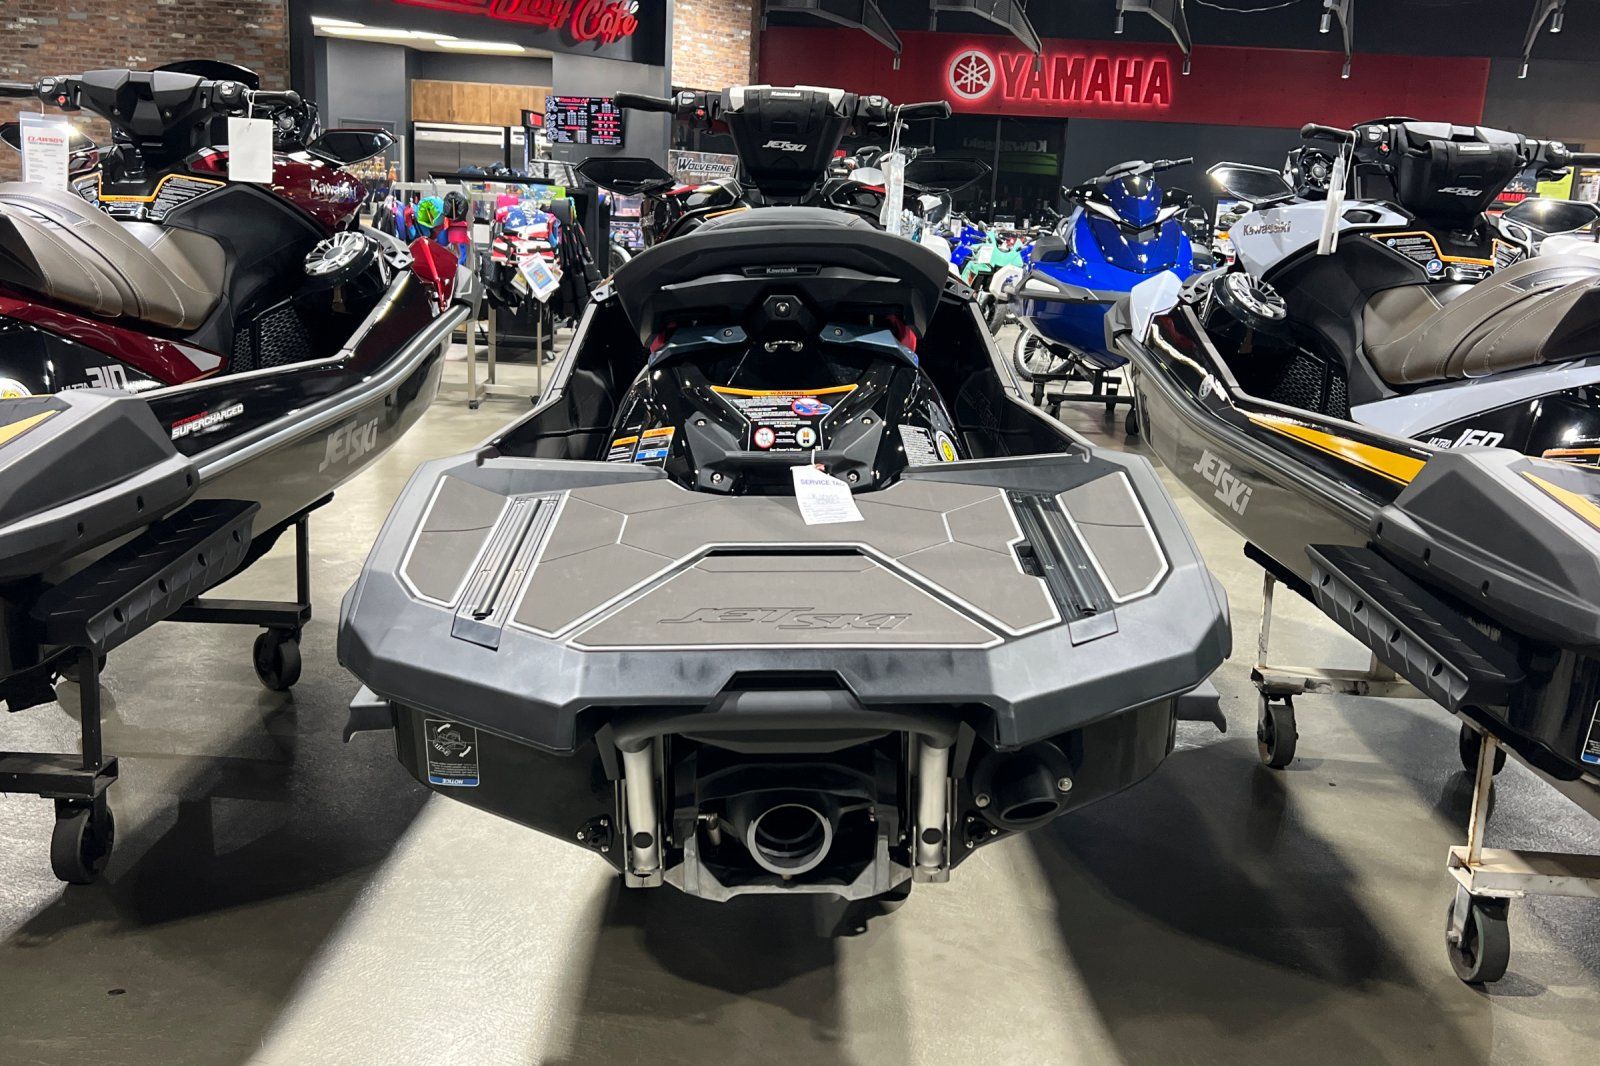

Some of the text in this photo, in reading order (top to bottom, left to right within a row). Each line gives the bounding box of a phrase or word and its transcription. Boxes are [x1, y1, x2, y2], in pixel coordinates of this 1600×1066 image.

[1000, 54, 1169, 105] YAMAHA
[677, 157, 734, 173] WOLVERINE
[1243, 220, 1291, 236] Kawasaki
[85, 364, 127, 390] 310
[171, 403, 244, 440] SUPERCHARGED
[1428, 428, 1505, 449] ULTRA 160
